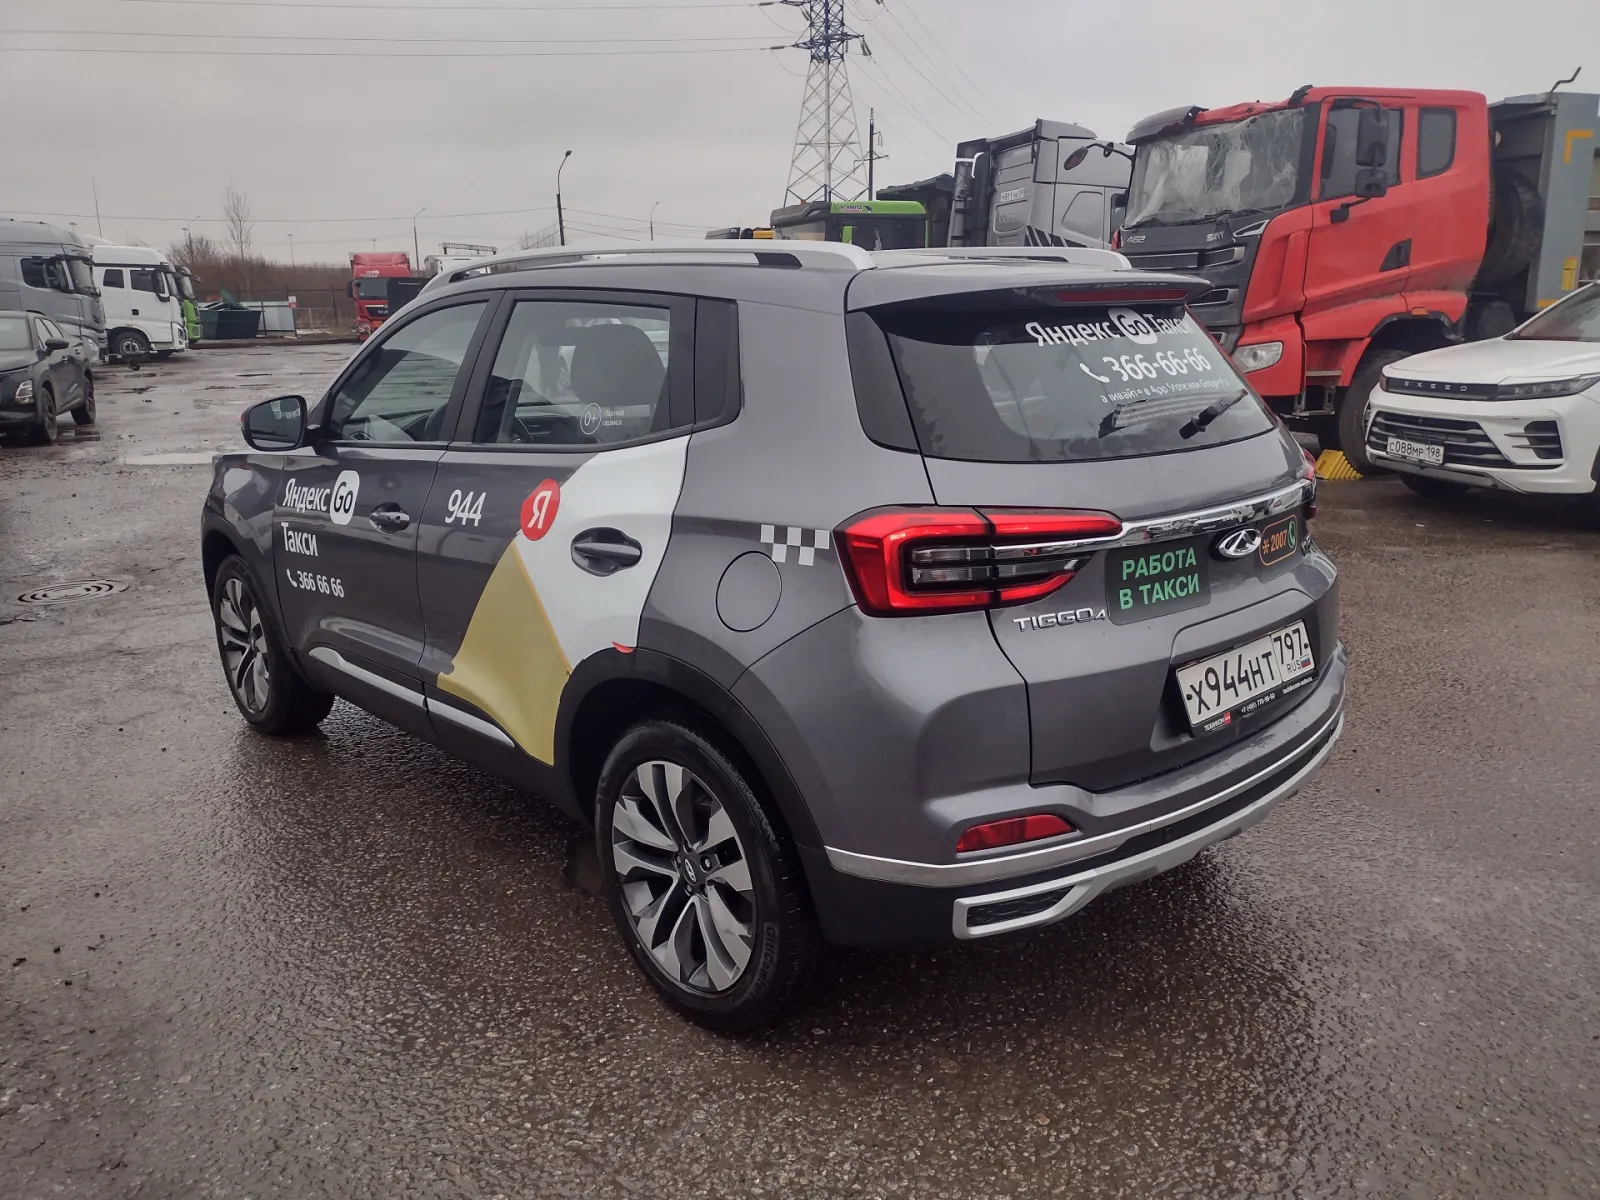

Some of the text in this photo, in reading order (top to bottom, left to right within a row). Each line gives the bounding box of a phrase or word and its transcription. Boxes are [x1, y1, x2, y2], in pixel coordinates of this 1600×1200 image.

[1025, 321, 1120, 347] Яндекс
[1102, 347, 1212, 382] 366-66-66
[1425, 446, 1441, 458] 198
[283, 478, 331, 513] Яндекс
[445, 489, 487, 527] 944
[281, 522, 318, 557] Такси
[1122, 547, 1197, 580] РАБОТА
[297, 570, 344, 598] 366 66 66
[1119, 573, 1200, 610] В ТАКСИ
[1273, 627, 1303, 665] 797
[1287, 659, 1302, 674] RUS
